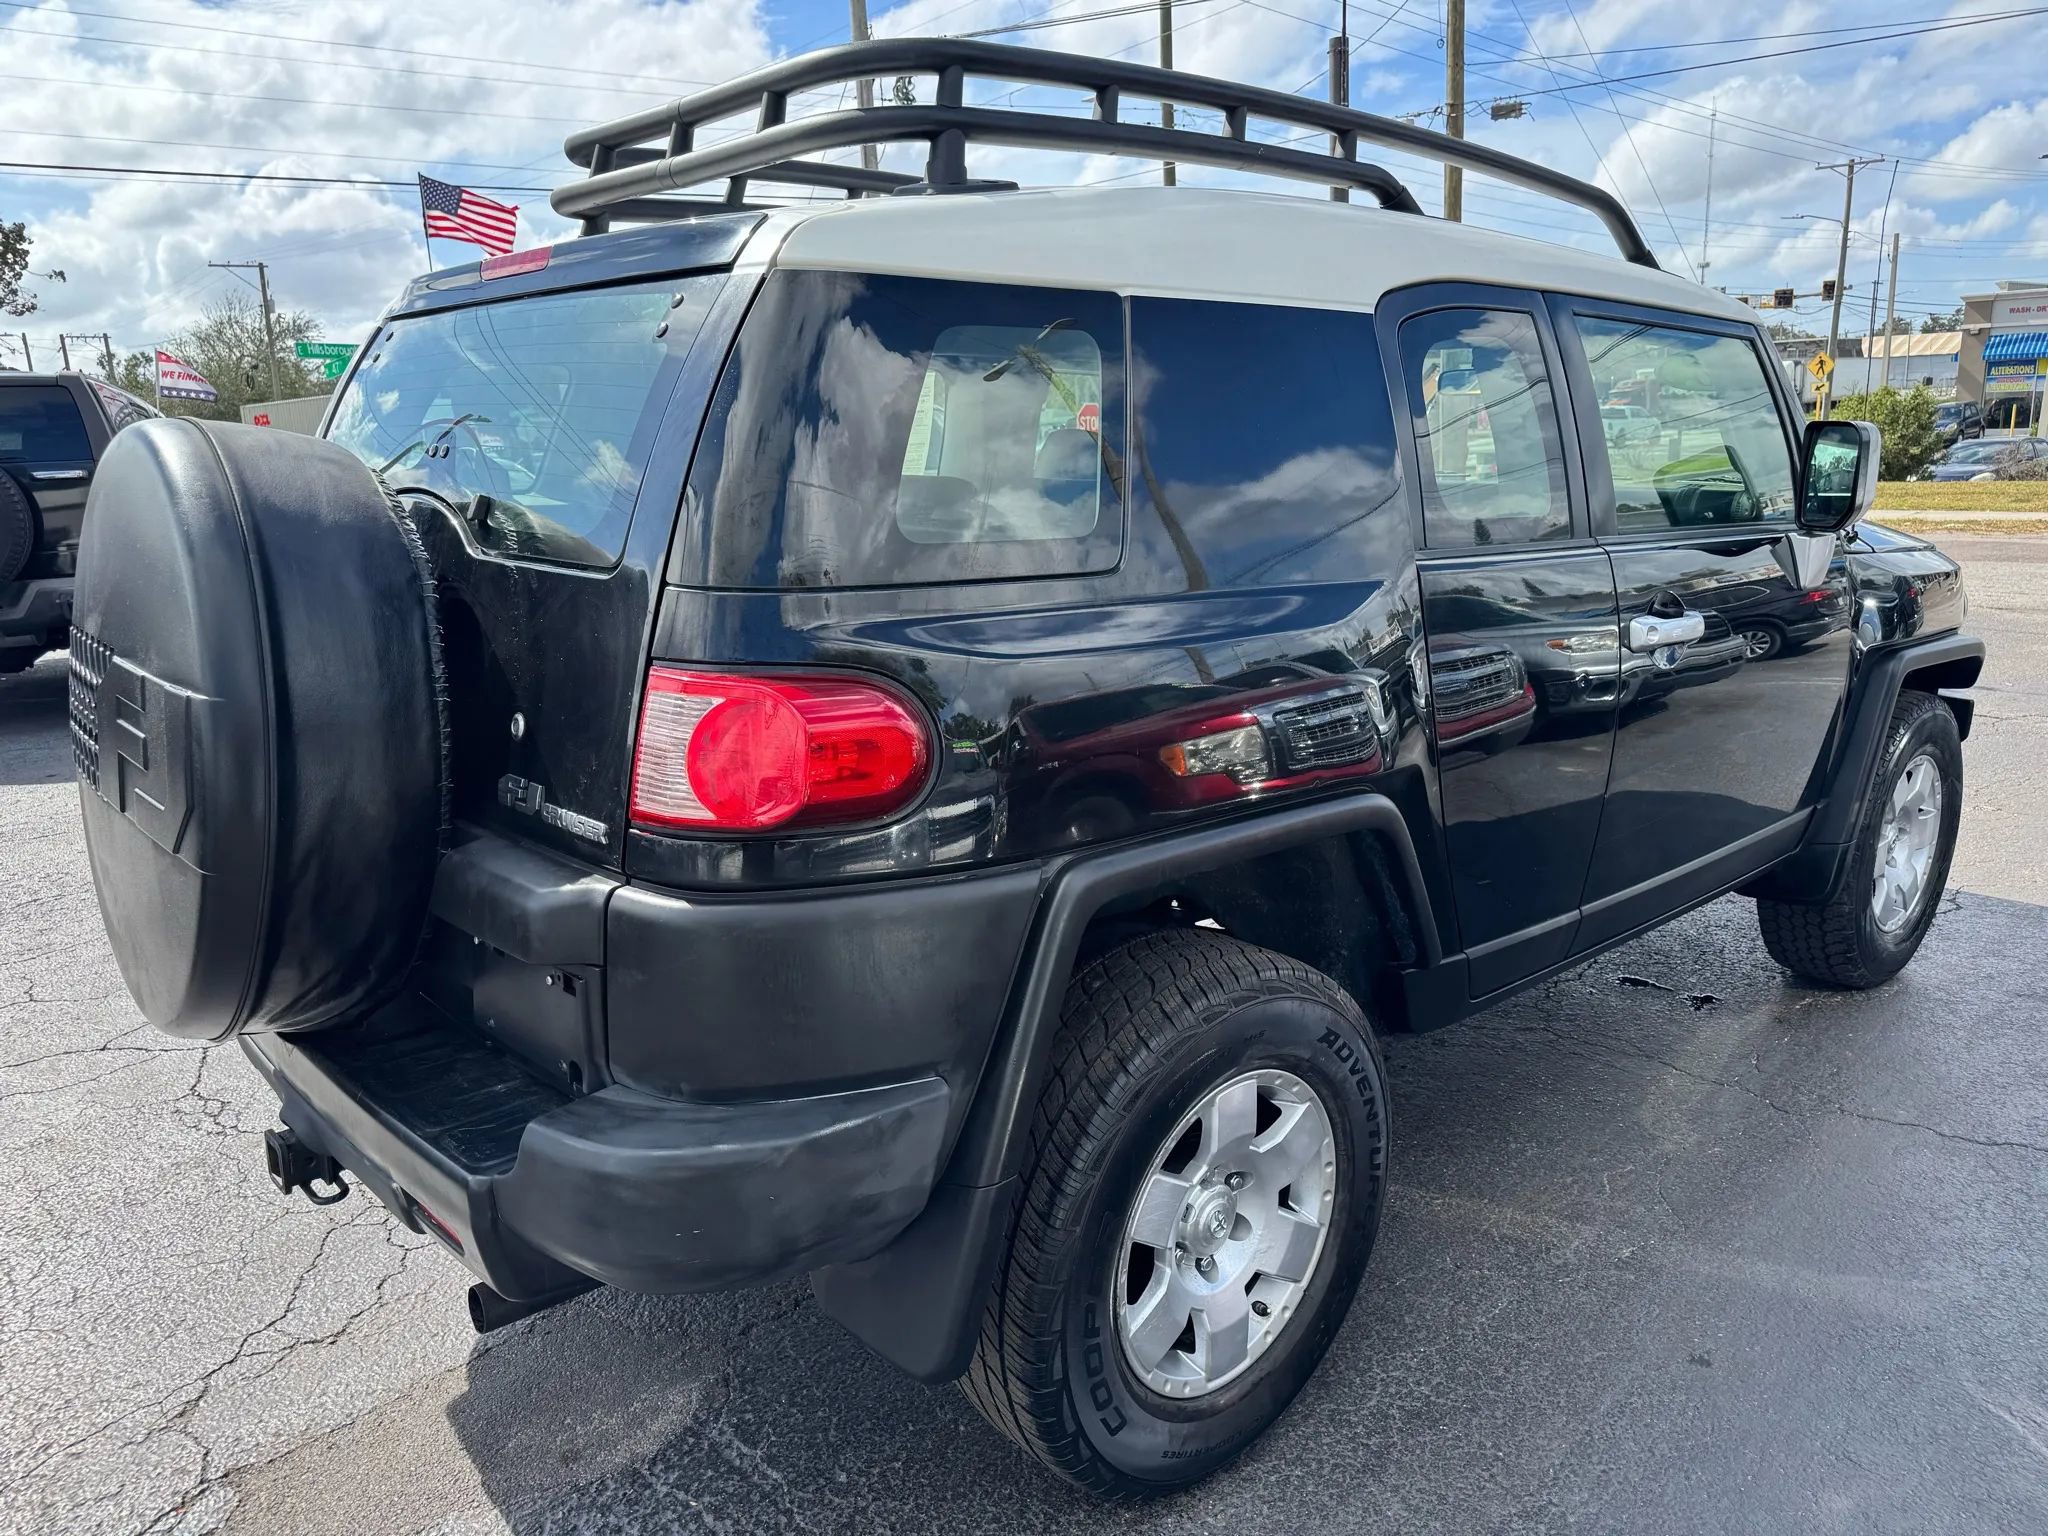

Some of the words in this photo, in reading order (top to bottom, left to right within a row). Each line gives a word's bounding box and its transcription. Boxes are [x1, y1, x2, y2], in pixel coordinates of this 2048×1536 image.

[2009, 306, 2031, 314] WASH
[2036, 305, 2048, 313] DR
[298, 346, 304, 355] E
[161, 370, 175, 379] WE
[1080, 416, 1098, 430] STO
[541, 803, 609, 844] CRUISER
